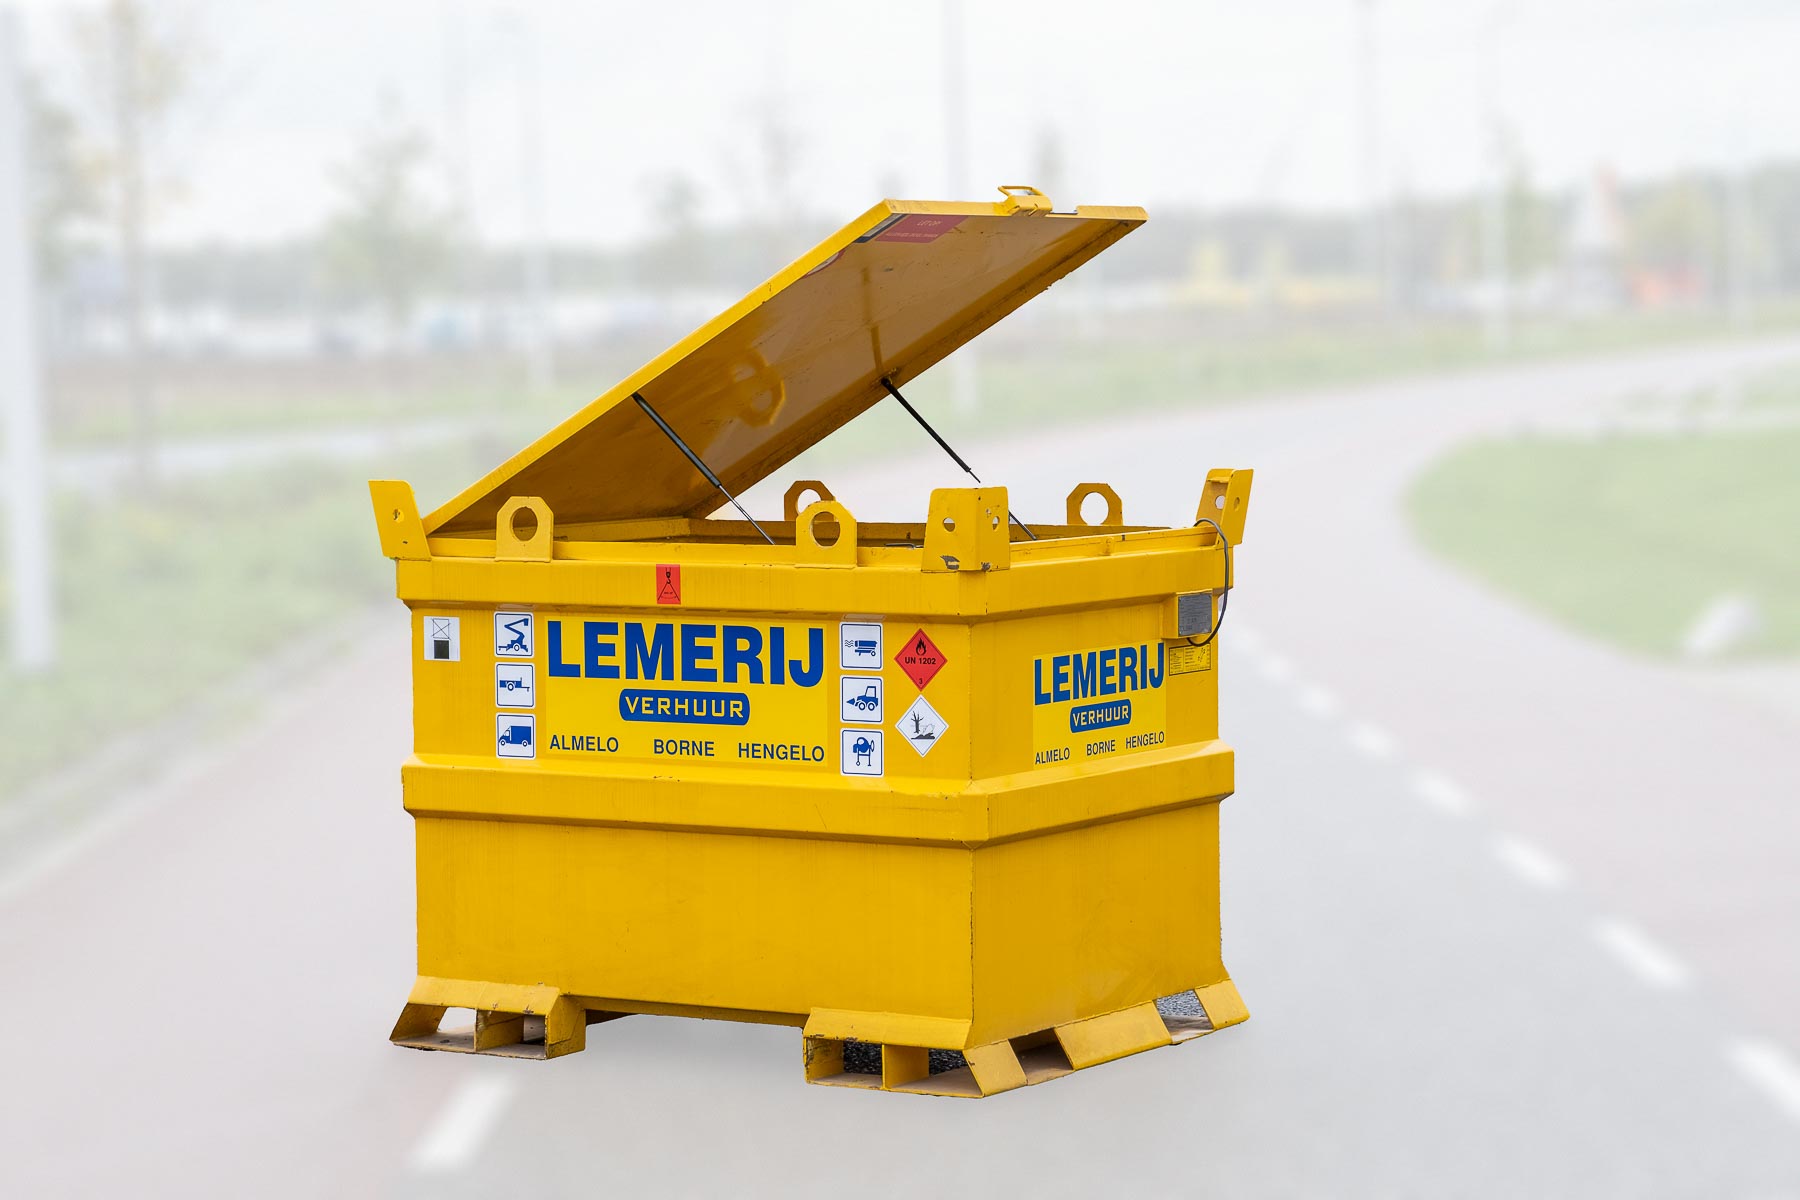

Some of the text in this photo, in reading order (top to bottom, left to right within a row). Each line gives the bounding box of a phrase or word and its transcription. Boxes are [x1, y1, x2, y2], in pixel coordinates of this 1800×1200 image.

[547, 620, 824, 688] LEMERIJ
[904, 657, 916, 665] UN
[918, 677, 923, 685] 3
[1034, 642, 1164, 706] LEMERIJ
[625, 696, 744, 719] VERHUUR
[1073, 705, 1129, 727] VERHUUR
[549, 734, 825, 762] ALMELO BORNE HENGELO
[1035, 731, 1165, 765] ALMELO BORNE HENGELO
